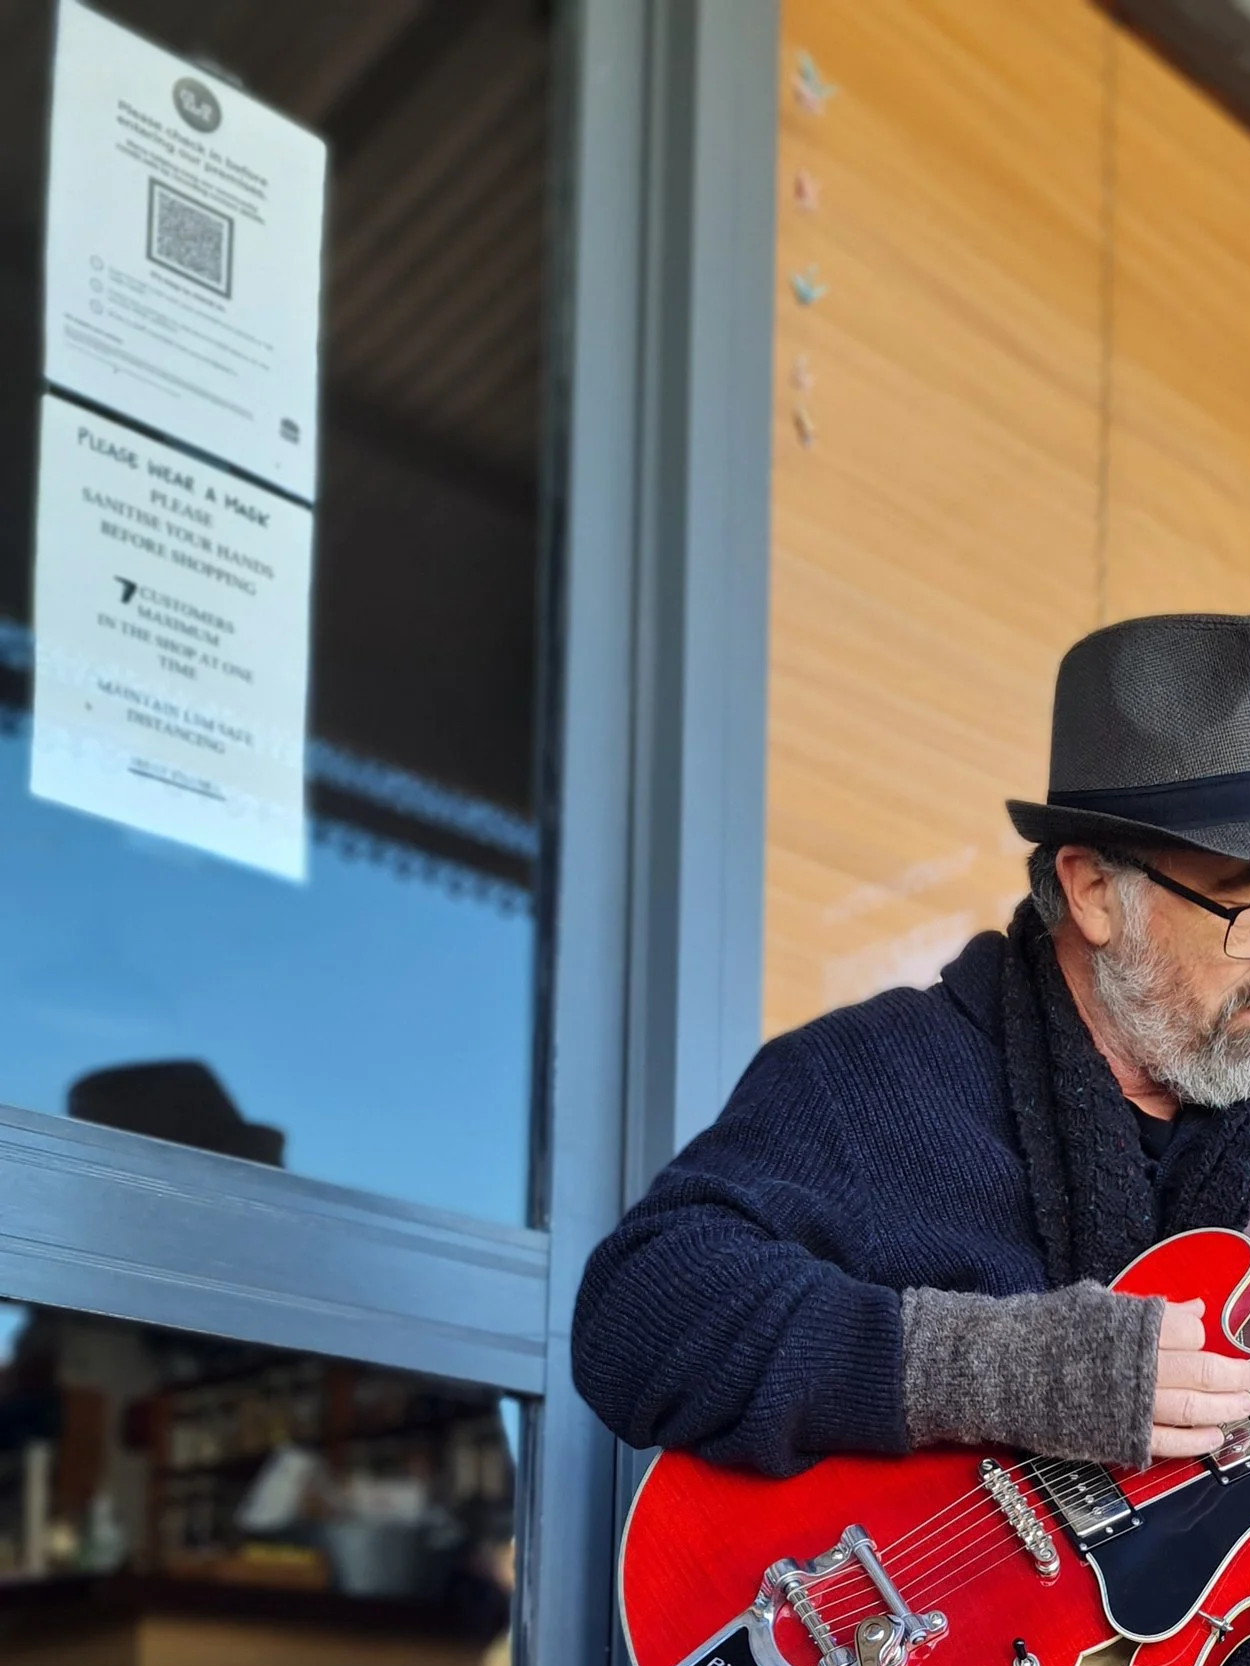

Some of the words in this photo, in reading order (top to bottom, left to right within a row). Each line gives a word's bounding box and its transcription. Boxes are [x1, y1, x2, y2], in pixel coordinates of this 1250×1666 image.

[78, 426, 139, 469] PLEASE
[148, 458, 195, 494] WEAR
[205, 486, 216, 503] A
[225, 494, 271, 528] MASK
[82, 487, 161, 532] SANITISE
[165, 521, 213, 552] YOUR
[217, 544, 275, 580] HANDS
[150, 489, 214, 528] PLEASE
[101, 520, 167, 557] BEFORE
[170, 549, 257, 596] SHOPPING
[121, 621, 152, 644] THE
[158, 654, 197, 681] TIME
